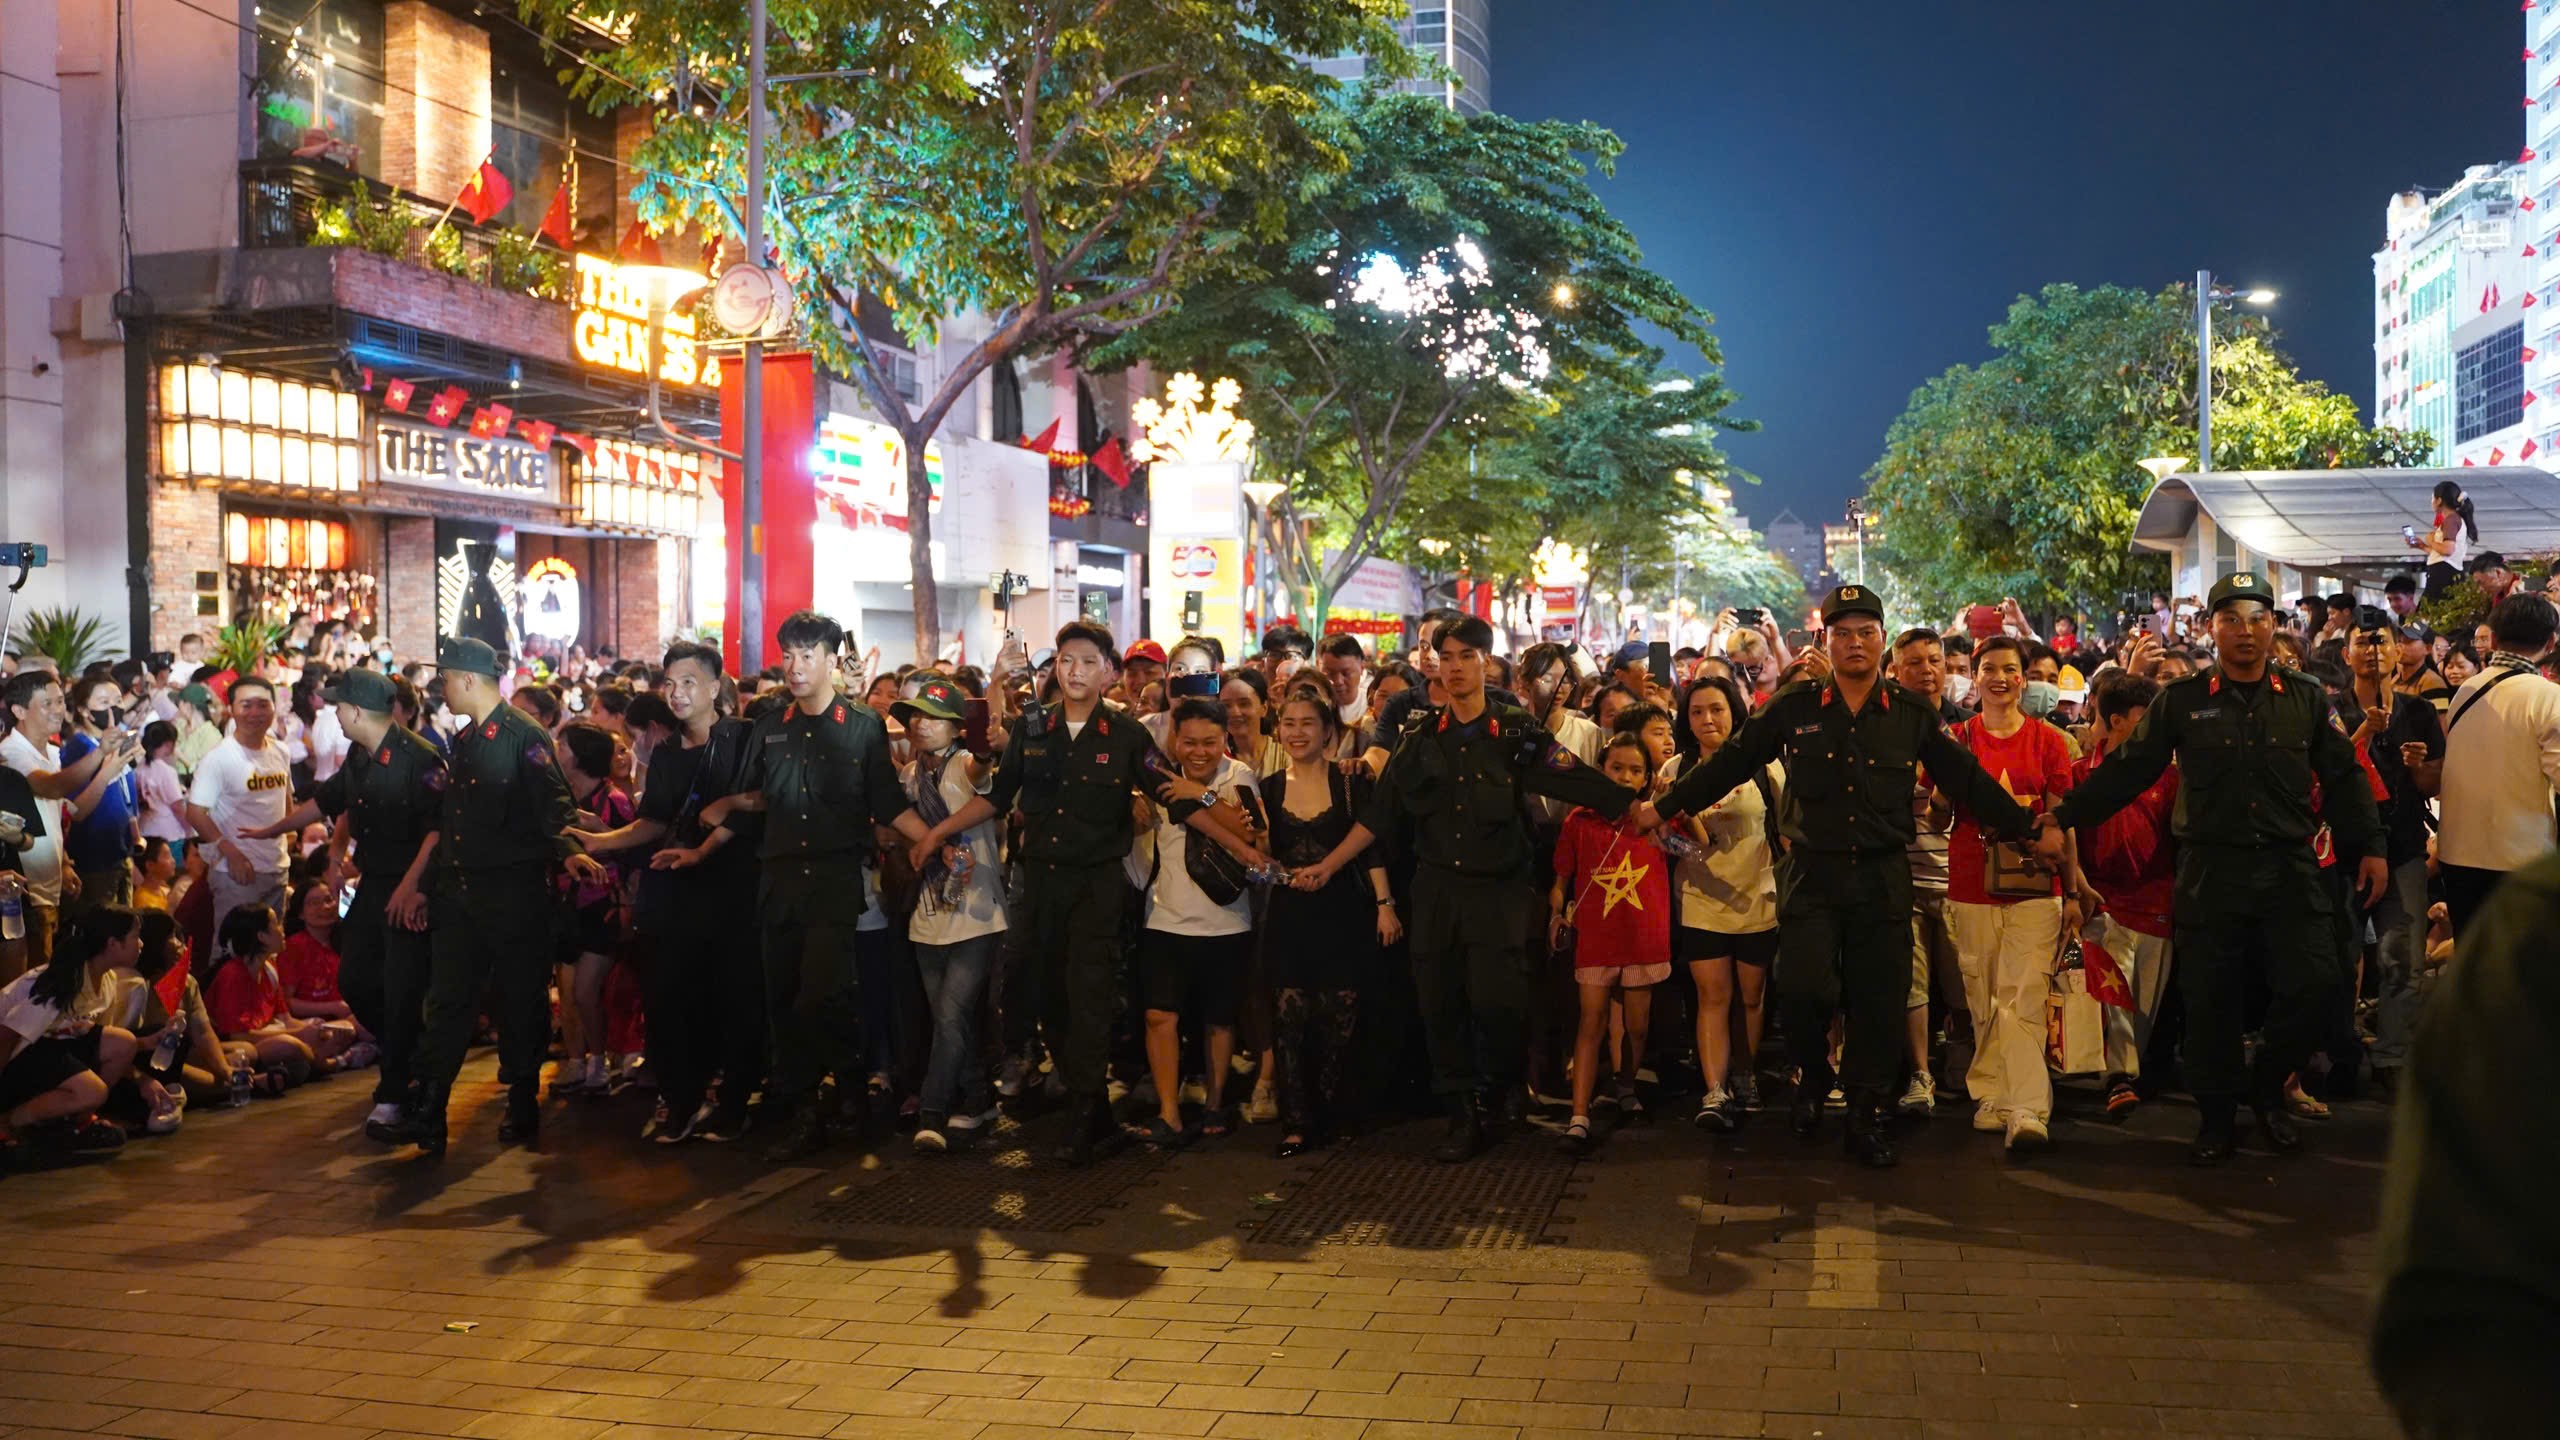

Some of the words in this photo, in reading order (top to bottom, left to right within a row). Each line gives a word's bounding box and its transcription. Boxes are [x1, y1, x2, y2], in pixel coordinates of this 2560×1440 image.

[378, 424, 449, 480] THE
[456, 437, 549, 494] SAKE
[247, 772, 286, 791] drew
